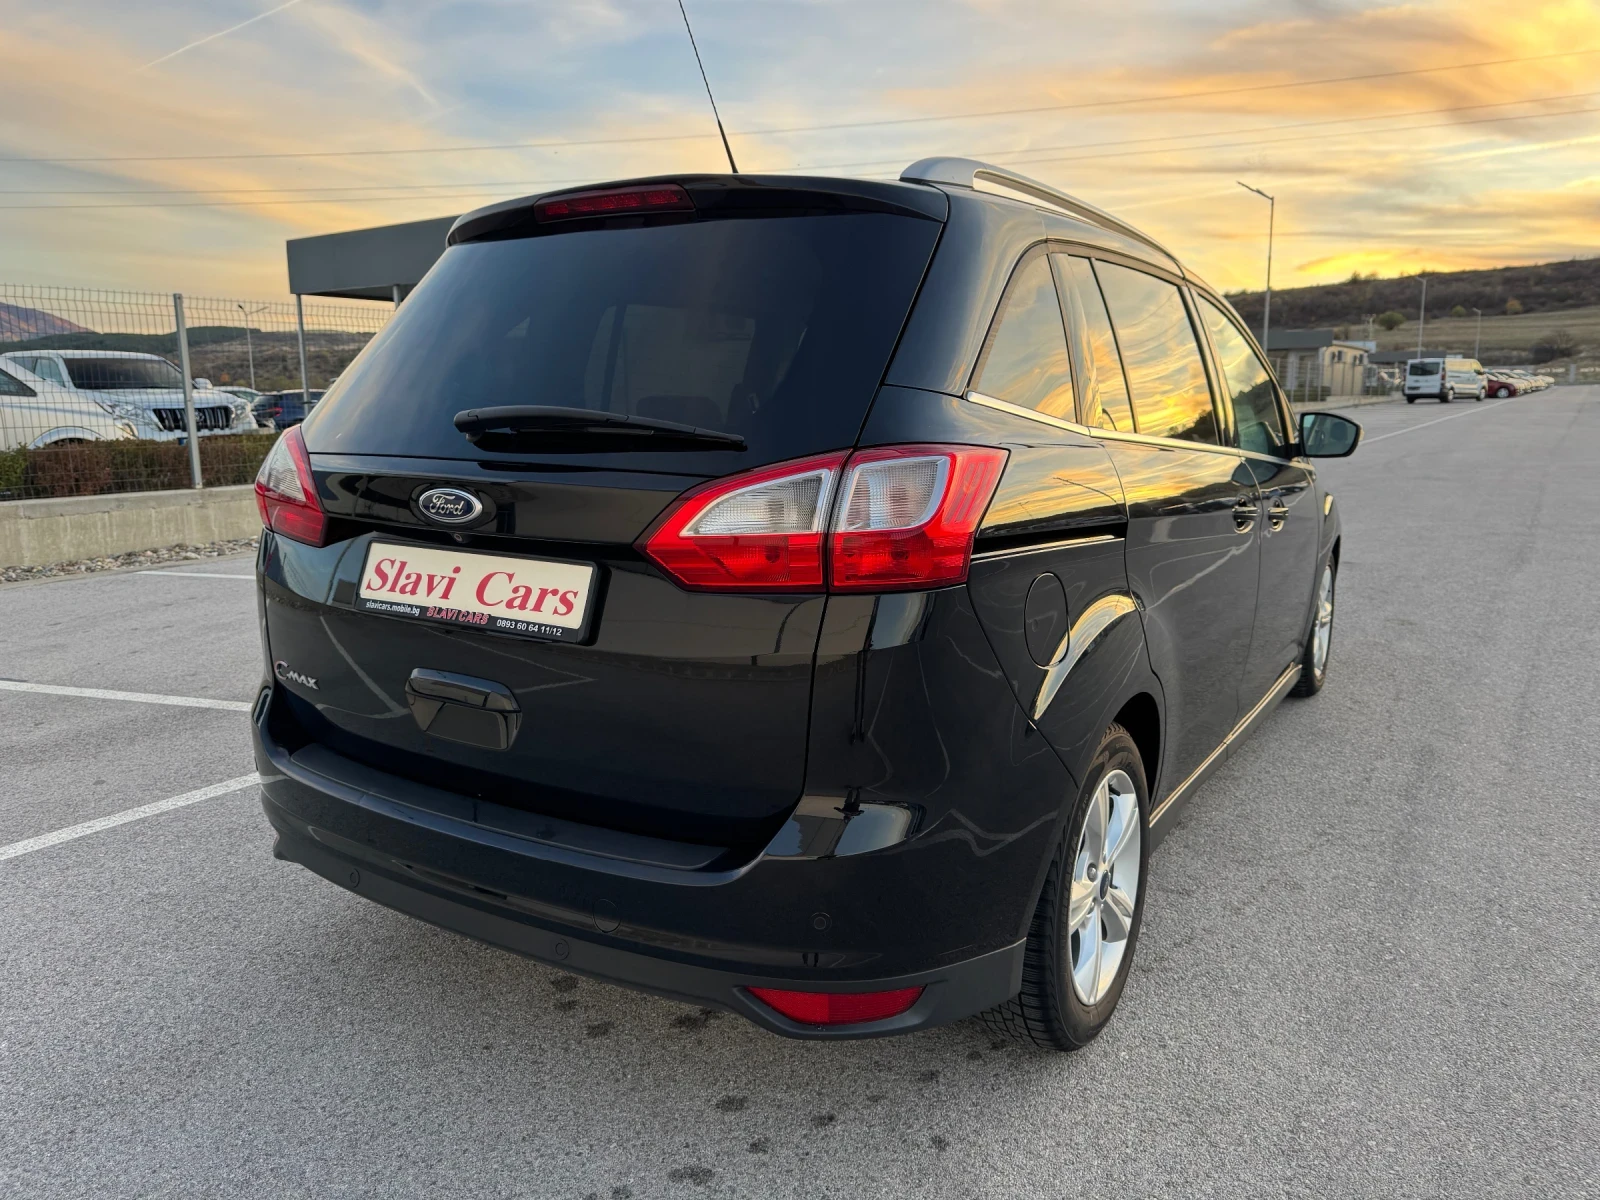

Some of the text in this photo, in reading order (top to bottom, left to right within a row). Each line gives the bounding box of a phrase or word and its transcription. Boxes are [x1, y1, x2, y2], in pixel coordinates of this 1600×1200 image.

[429, 493, 464, 515] Ford
[365, 558, 579, 616] Slavi Cars
[365, 600, 420, 616] slavicars.mobile.bg
[426, 606, 490, 625] SLAVI CARS
[496, 619, 562, 636] 0893 60 64 11/12
